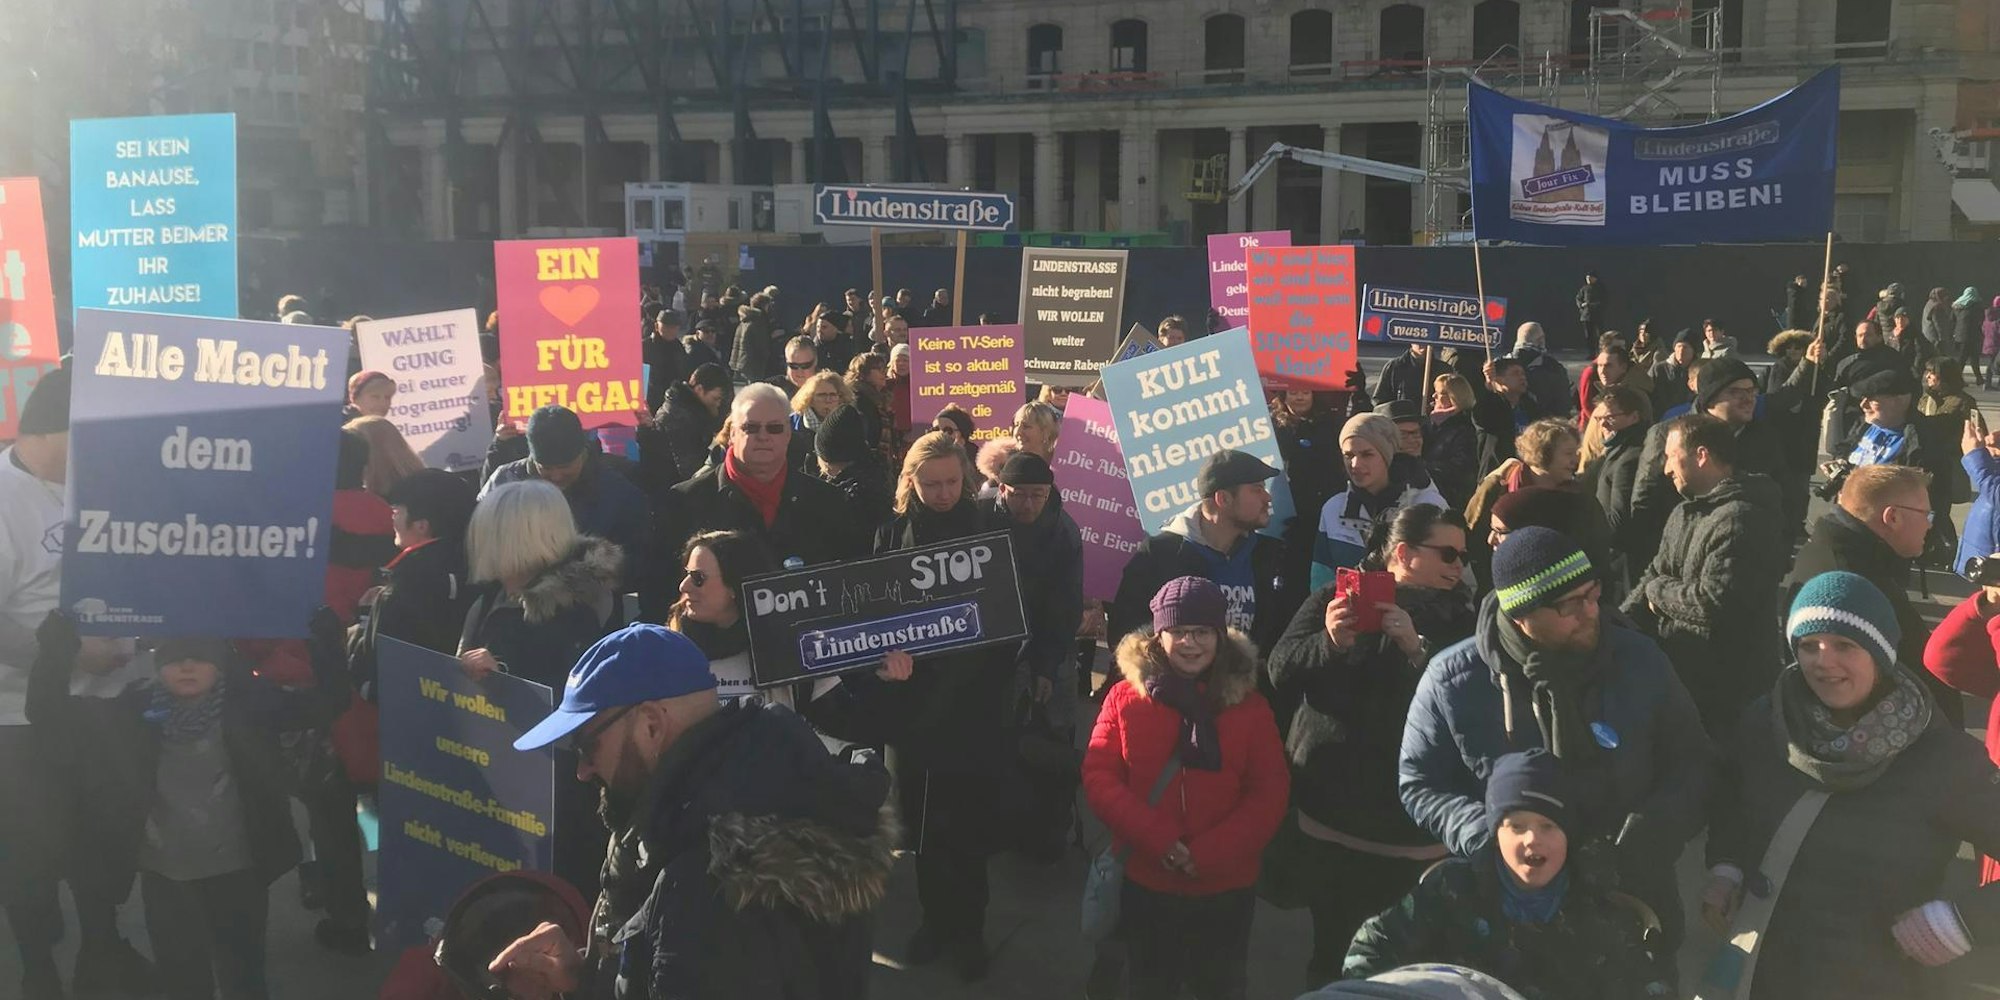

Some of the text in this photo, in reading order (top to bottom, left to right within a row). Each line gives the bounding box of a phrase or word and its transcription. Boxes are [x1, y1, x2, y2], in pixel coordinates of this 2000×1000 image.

[115, 138, 190, 159] SEI KEIN
[106, 168, 200, 188] BANAUSE,
[1659, 158, 1753, 186] MUSS
[130, 198, 176, 216] LASS
[832, 190, 1000, 226] Lindenstraße
[1630, 183, 1782, 214] BLEIBEN!
[78, 224, 228, 248] MUTTER BEIMER
[1240, 236, 1259, 248] Die
[138, 258, 168, 274] IHR
[536, 246, 600, 281] EIN
[1032, 260, 1118, 274] LINDENSTRASSE
[106, 284, 200, 306] ZUHAUSE!
[1032, 285, 1114, 301] nicht begraben!
[1373, 290, 1478, 316] Lindenstraße
[1037, 310, 1104, 323] WIR WOLLEN
[1218, 306, 1250, 317] Deuts
[382, 323, 456, 348] WÄHLT
[918, 335, 1014, 351] Keine TV-Serie
[1052, 335, 1086, 347] weiter
[1256, 332, 1350, 352] SENDUNG
[1393, 324, 1428, 338] muss
[95, 331, 329, 390] Alle Macht
[392, 349, 454, 372] GUNG
[536, 334, 610, 371] FÜR
[1024, 357, 1072, 370] schwarze
[1274, 352, 1332, 376] klaut!
[925, 358, 1009, 373] ist so aktuell
[1136, 349, 1222, 399] KULT
[398, 375, 466, 394] ei eurer
[919, 380, 1017, 398] und zeitgemäß
[390, 396, 480, 418] rogramm-
[506, 379, 640, 418] HELGA!
[1128, 378, 1250, 438] kommt
[972, 404, 992, 418] die
[968, 426, 1013, 441] straße!
[1084, 420, 1120, 444] Helg
[160, 426, 252, 472] dem
[1128, 416, 1272, 478] niemals
[1097, 458, 1128, 479] Abs
[1060, 488, 1094, 506] geht
[1096, 498, 1122, 513] mir
[77, 510, 318, 559] Zuschauer!
[752, 545, 993, 616] Don't STOP
[812, 614, 968, 661] Lindenstraße
[418, 676, 506, 722] Wir wollen
[435, 736, 490, 767] unsere
[384, 760, 546, 837] Lindenstraße-Familie
[404, 819, 442, 848] nicht
